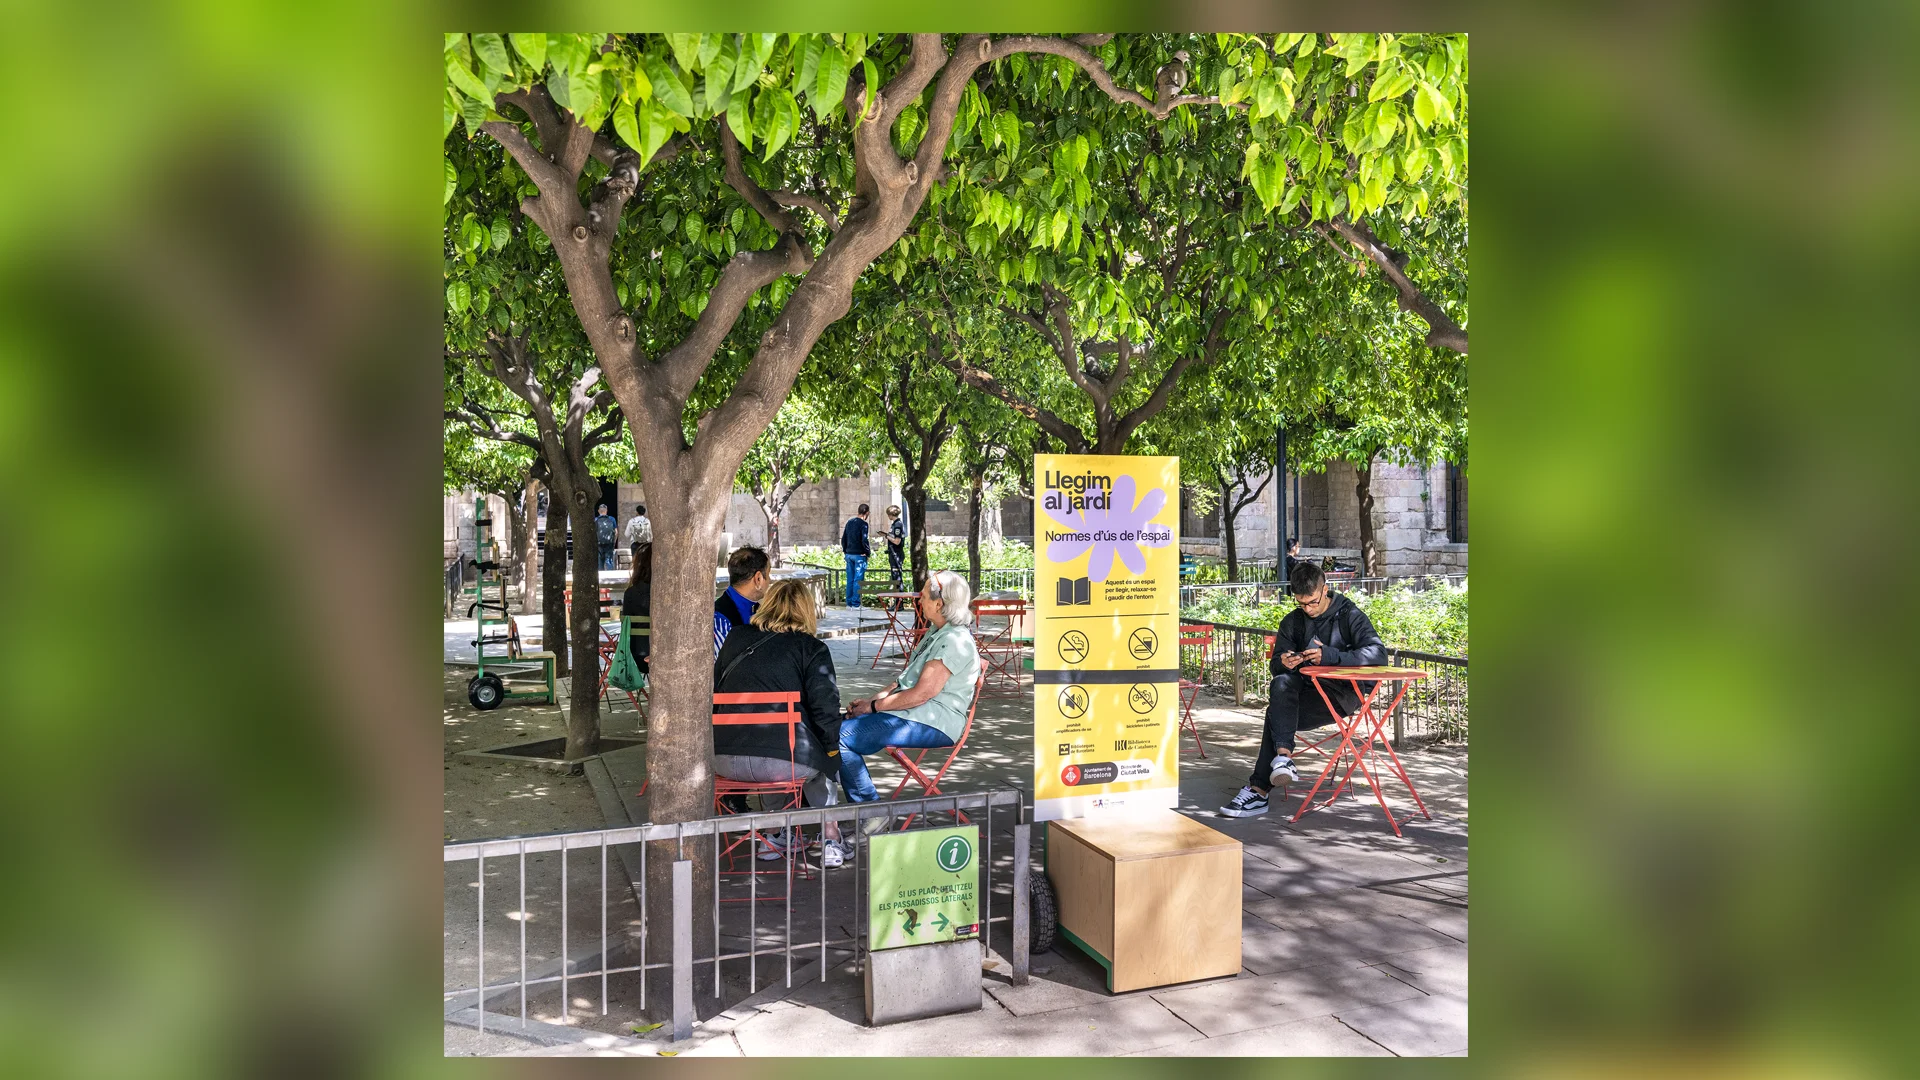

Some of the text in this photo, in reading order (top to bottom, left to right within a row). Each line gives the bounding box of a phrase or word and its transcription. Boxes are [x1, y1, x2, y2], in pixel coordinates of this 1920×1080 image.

[1045, 470, 1111, 494] Llegim
[1045, 491, 1112, 515] al jardí
[1045, 529, 1170, 544] Normes d'ús de l'espai
[1108, 594, 1125, 602] gaudir
[1083, 771, 1112, 780] Barcelona
[1084, 766, 1105, 774] Ajuntament
[898, 890, 906, 898] SI
[907, 888, 917, 897] US
[878, 893, 973, 911] ELS PASSADISSOS LATERALS
